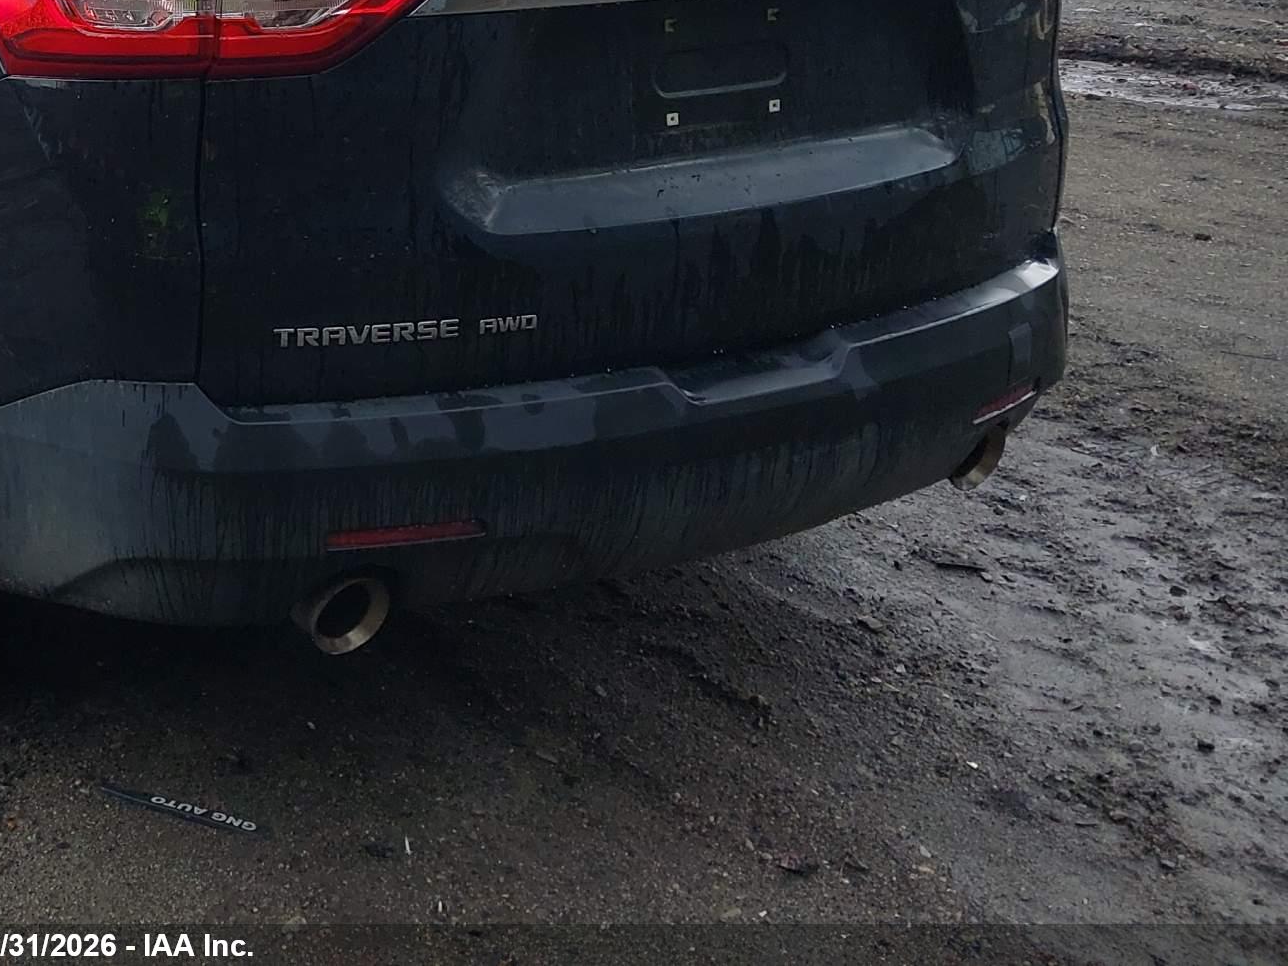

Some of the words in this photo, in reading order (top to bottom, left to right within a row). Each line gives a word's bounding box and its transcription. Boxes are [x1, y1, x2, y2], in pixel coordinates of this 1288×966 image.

[273, 318, 459, 348] TRAVERSE
[479, 314, 538, 335] AWD
[150, 796, 209, 815] AUTO
[210, 811, 257, 831] GNG
